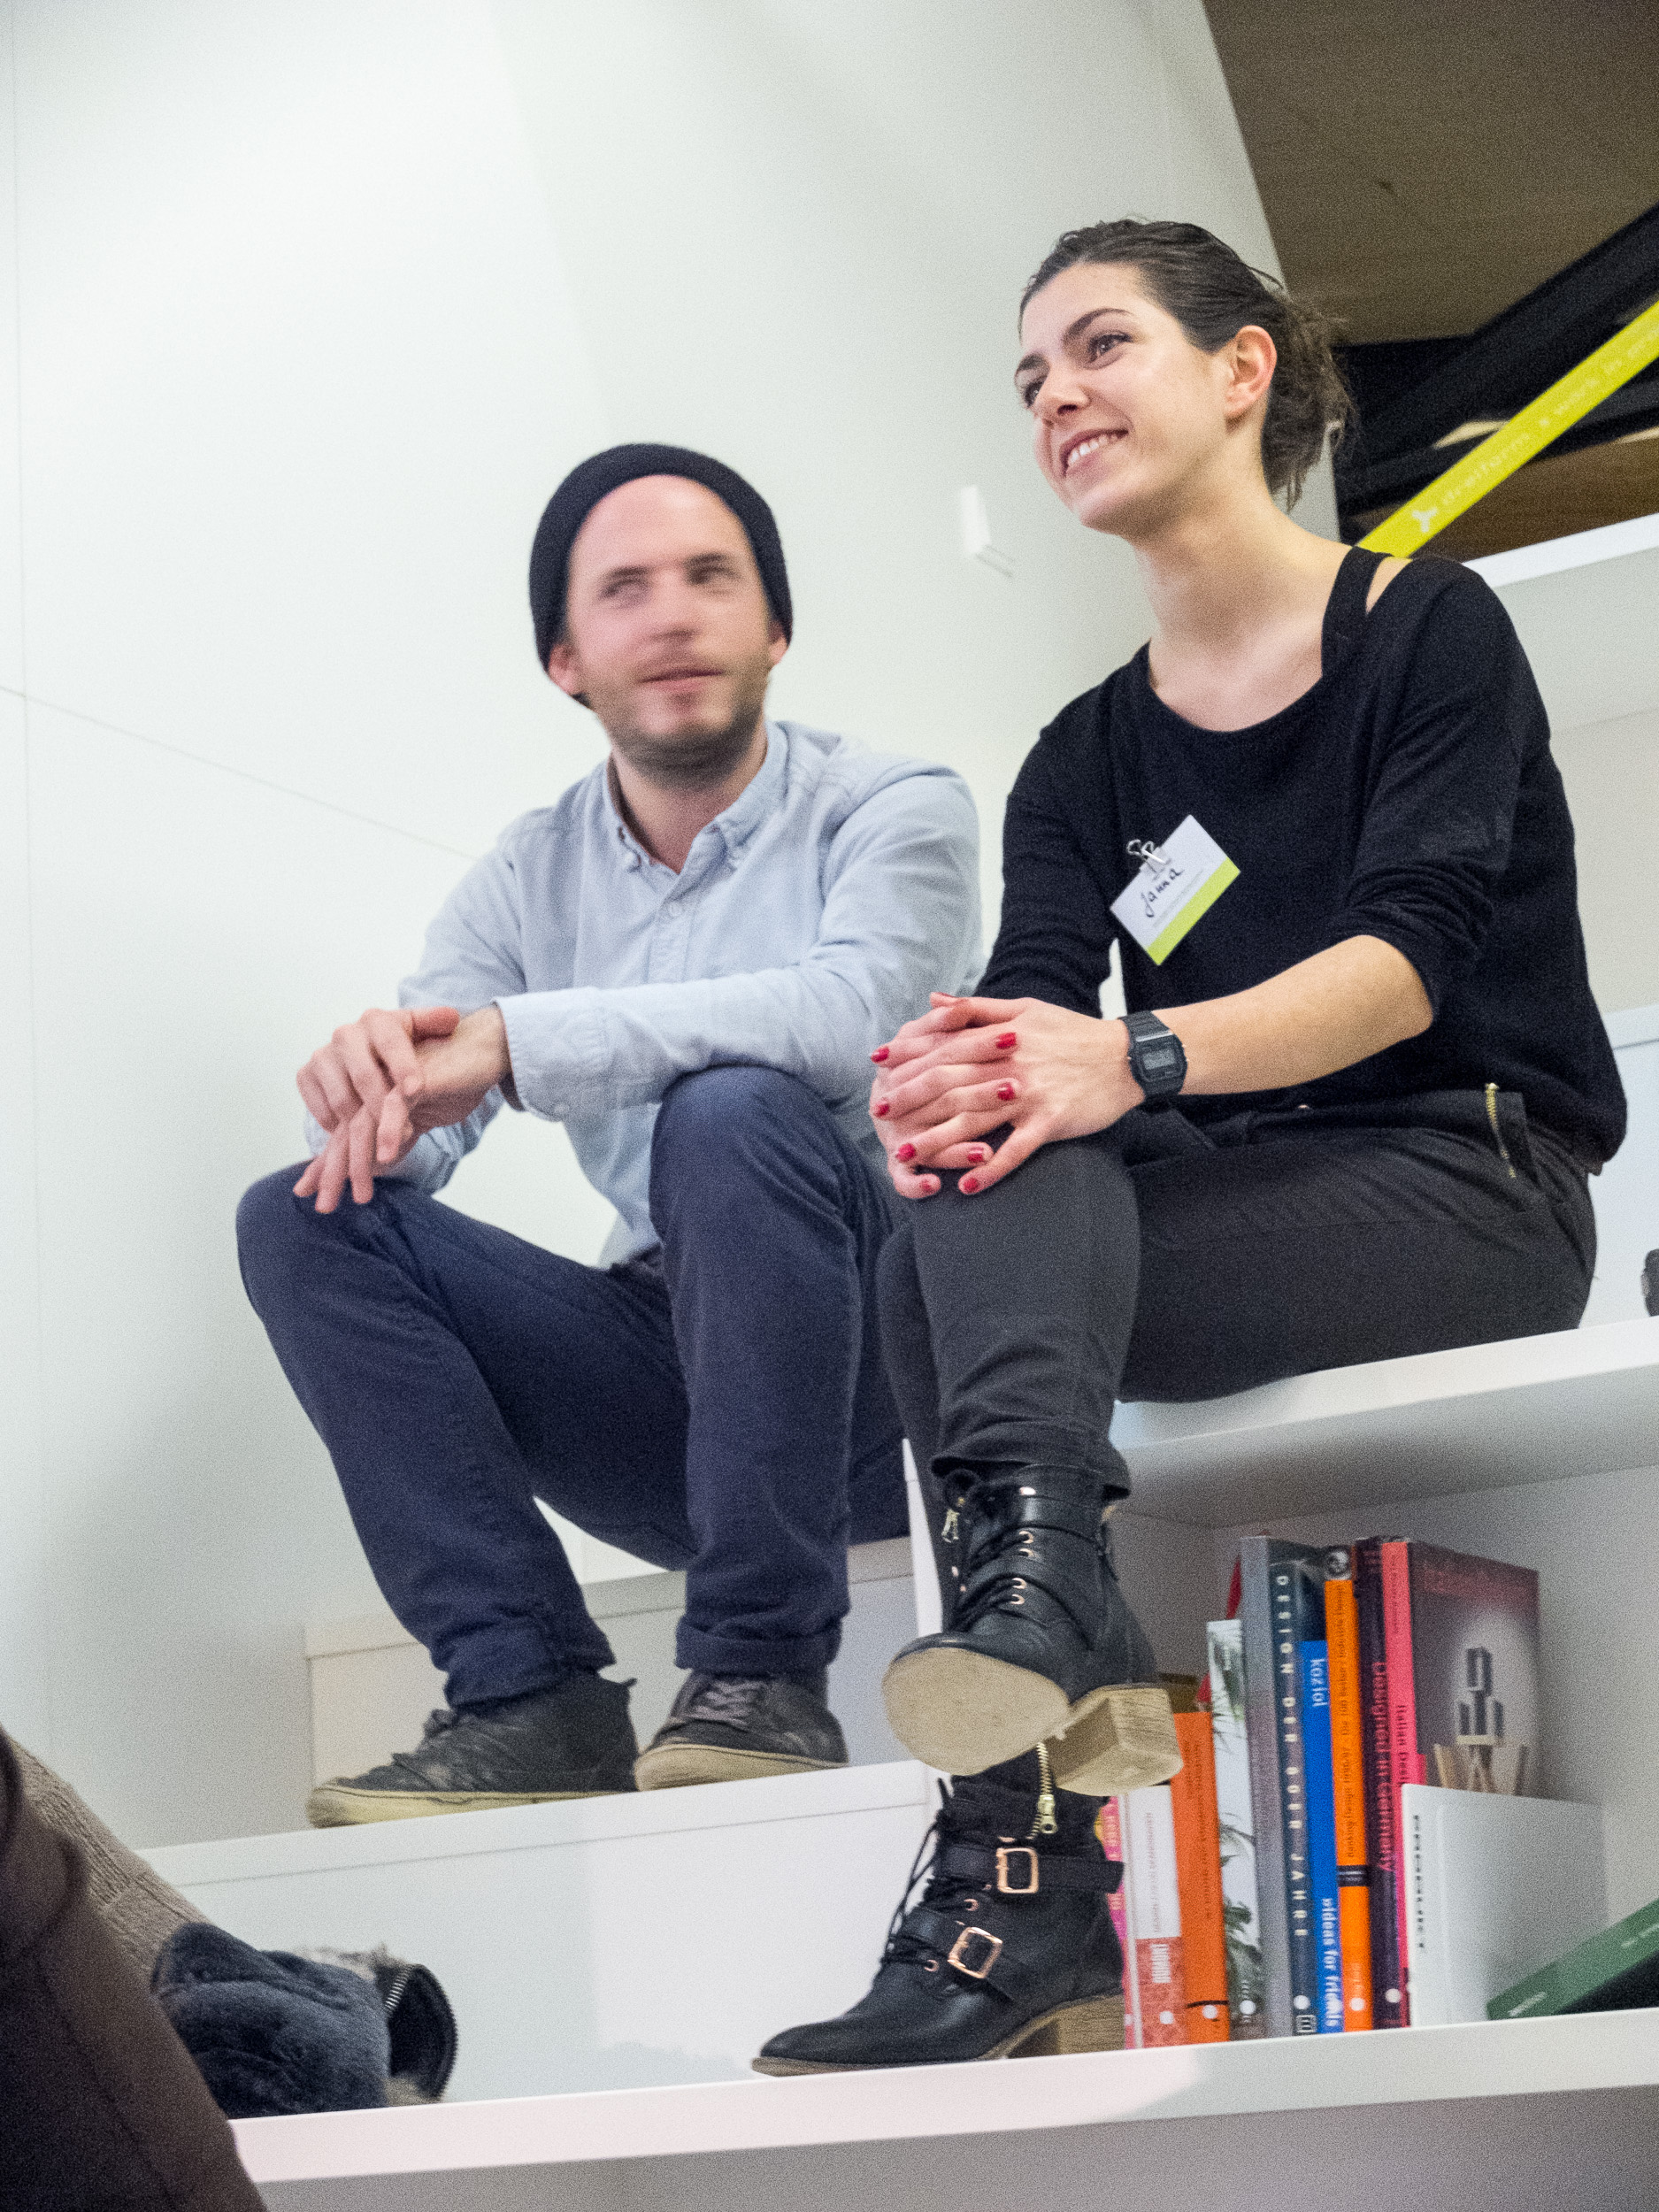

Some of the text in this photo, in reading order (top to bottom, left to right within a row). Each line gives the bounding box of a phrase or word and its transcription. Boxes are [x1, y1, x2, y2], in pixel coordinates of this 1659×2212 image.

[1277, 1575, 1294, 1673] DESIGN
[1310, 1658, 1328, 1707] koziol
[1282, 1696, 1297, 1742] DER
[1397, 1704, 1408, 1746] Italian
[1371, 1662, 1396, 1871] Designed in Germany
[1290, 1854, 1308, 1936] JAHRE
[1324, 1950, 1340, 1970] for
